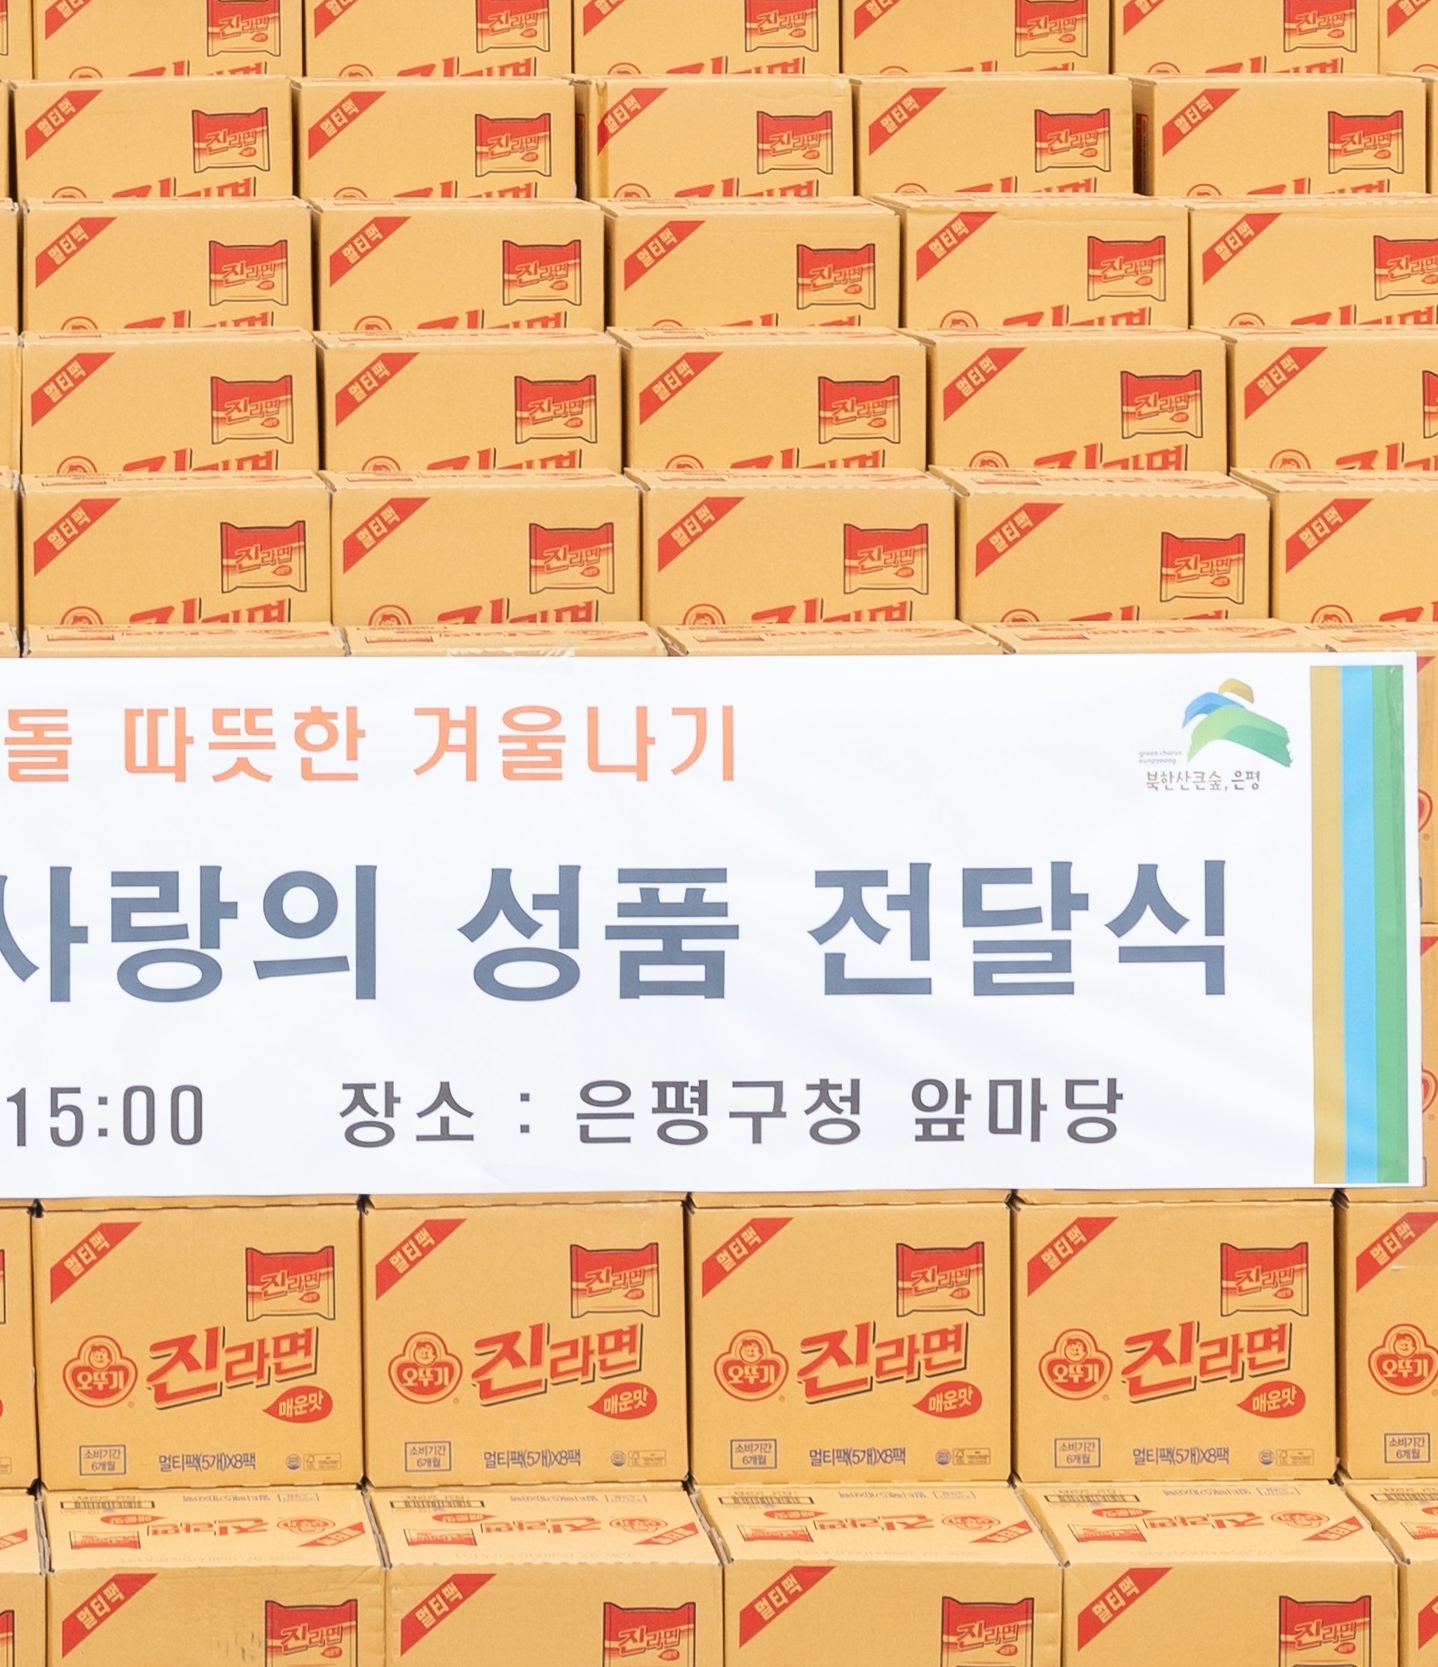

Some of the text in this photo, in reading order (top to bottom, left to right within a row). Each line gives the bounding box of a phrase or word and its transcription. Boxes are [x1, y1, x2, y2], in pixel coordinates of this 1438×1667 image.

[122, 704, 367, 786] 따뜻한
[412, 704, 737, 786] 겨울나기
[1146, 770, 1260, 792] 북한산큰숲, 은평
[458, 861, 740, 1004] 성품
[808, 858, 1229, 1001] 전달식
[7, 1083, 205, 1148] 15:00
[339, 1080, 478, 1150] 장소
[575, 1078, 866, 1148] 은평구청
[910, 1076, 1124, 1146] 앞마당
[77, 1371, 125, 1390] 오뚜기
[472, 1323, 641, 1406] 진라면
[929, 1387, 973, 1413] 매운맛
